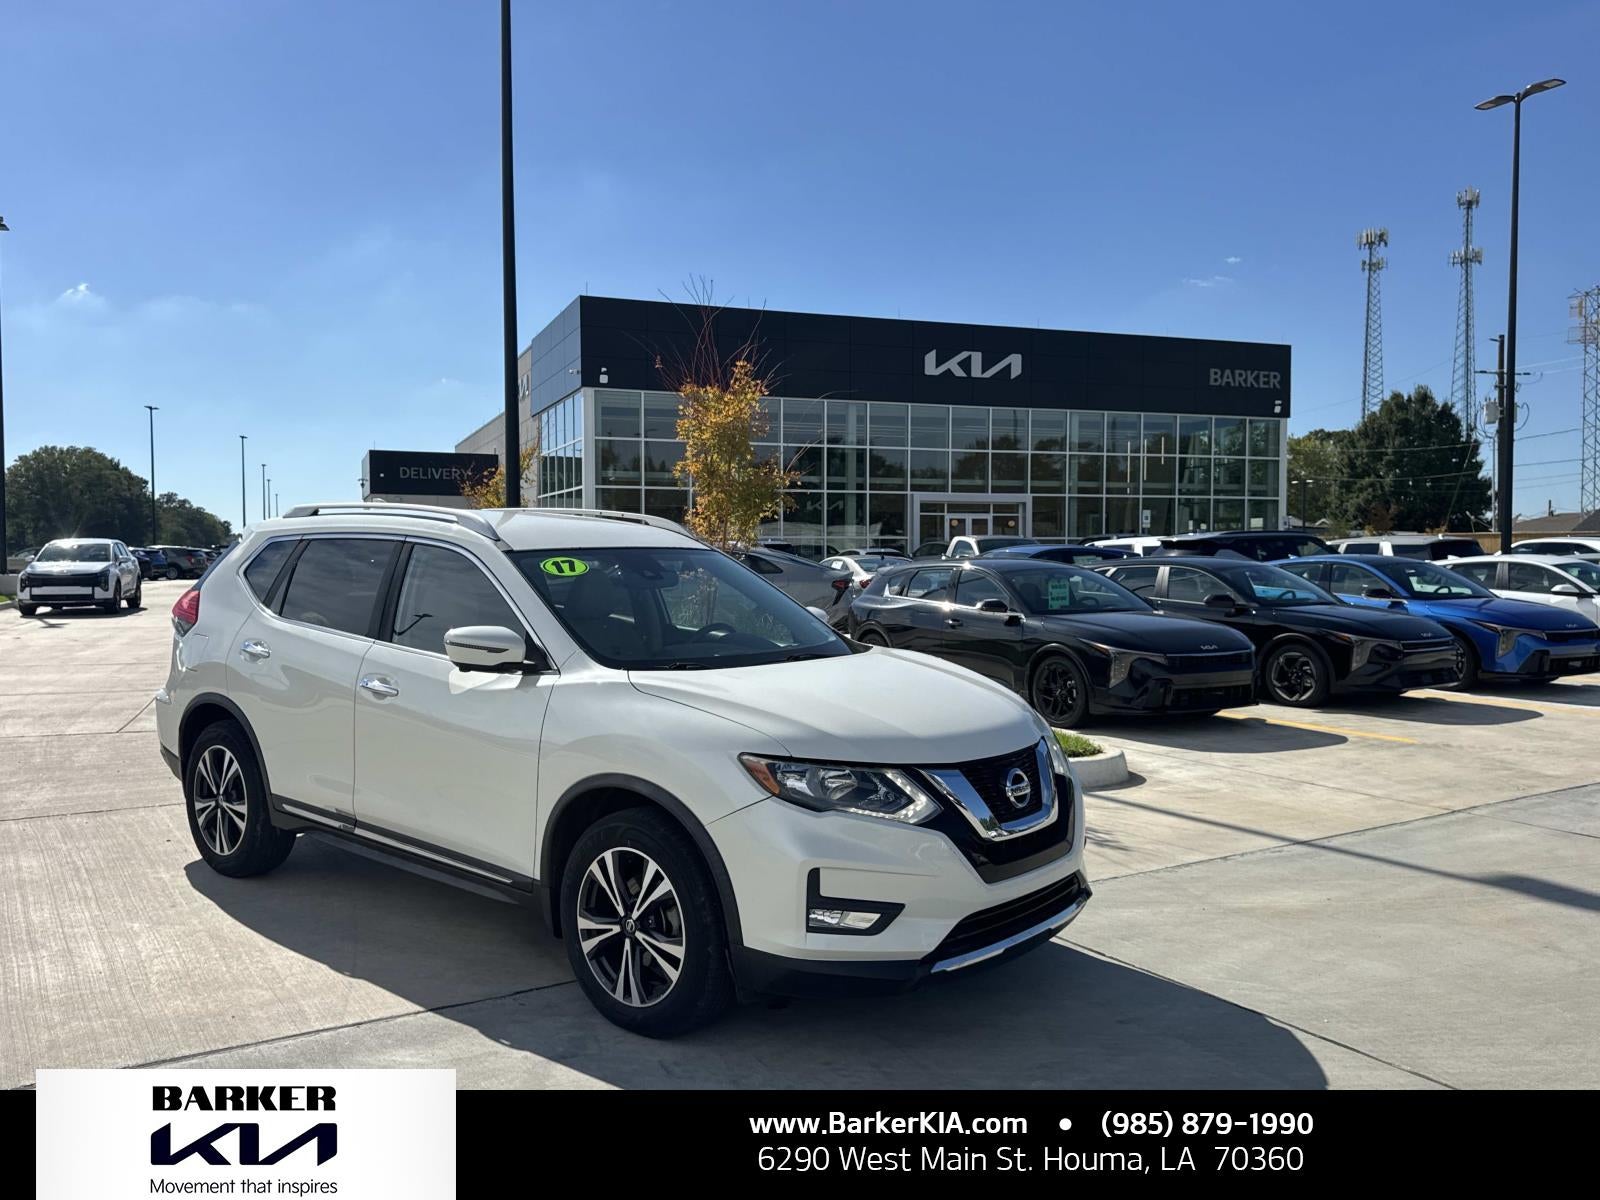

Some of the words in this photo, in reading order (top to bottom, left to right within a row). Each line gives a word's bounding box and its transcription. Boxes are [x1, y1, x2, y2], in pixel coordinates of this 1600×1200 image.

[924, 349, 1022, 380] KIA
[1209, 368, 1281, 389] BARKER
[400, 466, 469, 480] DELIVERY
[551, 560, 576, 573] 17
